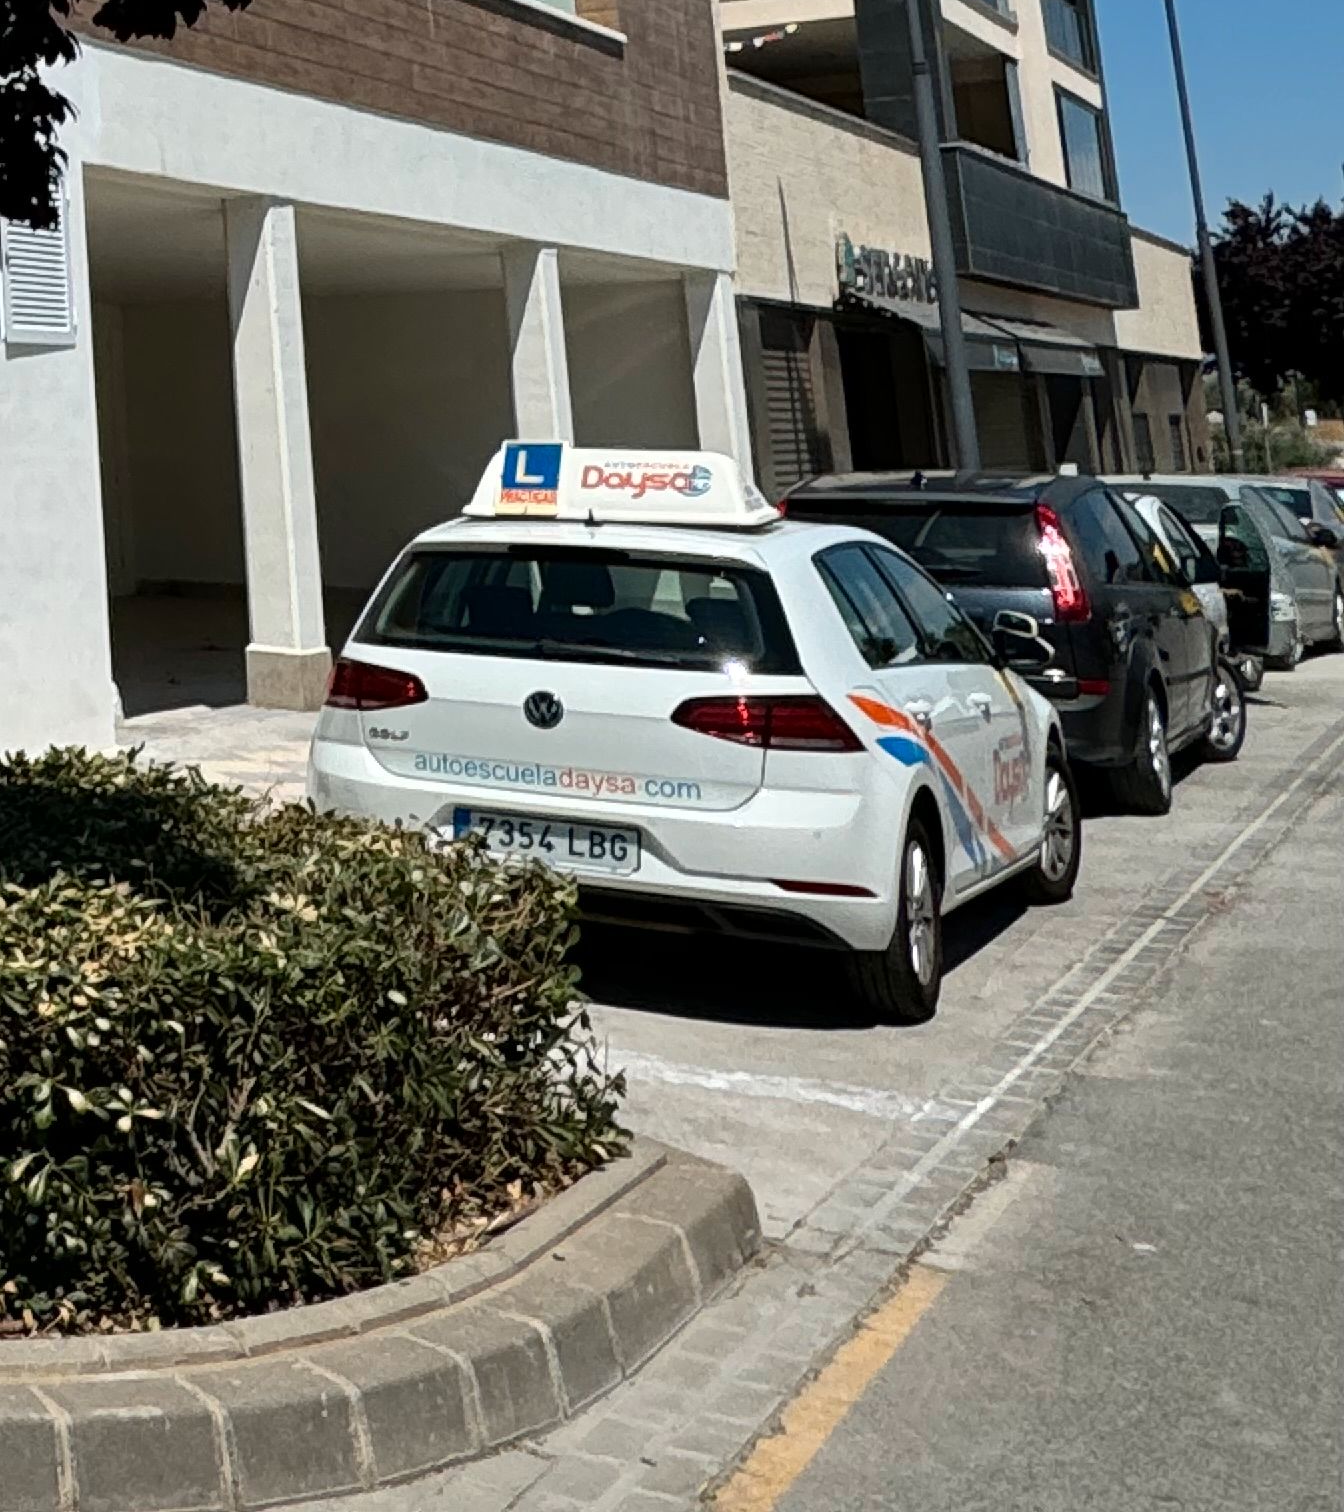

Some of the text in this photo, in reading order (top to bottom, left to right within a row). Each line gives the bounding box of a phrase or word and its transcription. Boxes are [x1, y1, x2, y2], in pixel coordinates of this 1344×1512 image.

[515, 450, 544, 484] L
[479, 816, 628, 862] 7354 LBG
